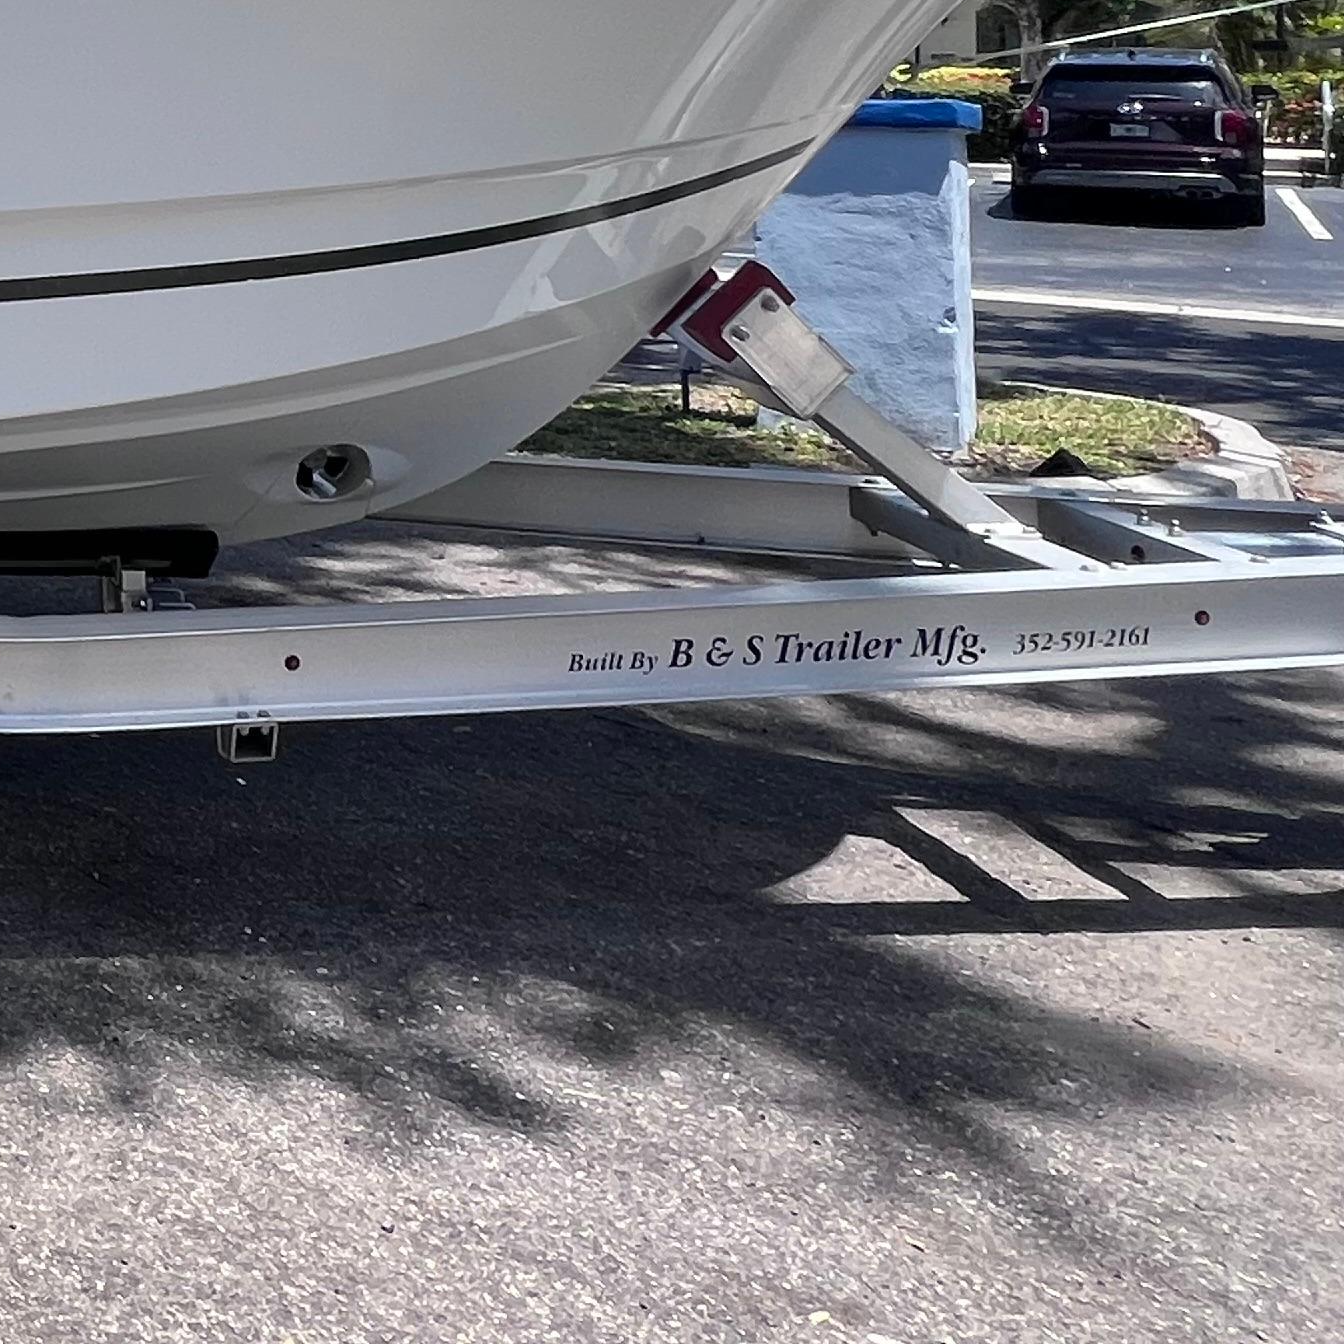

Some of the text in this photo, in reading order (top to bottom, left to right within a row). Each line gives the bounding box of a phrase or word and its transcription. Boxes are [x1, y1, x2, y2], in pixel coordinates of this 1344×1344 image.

[567, 624, 1150, 675] Built By B & S Trailer Mfg. 352-591-2161
